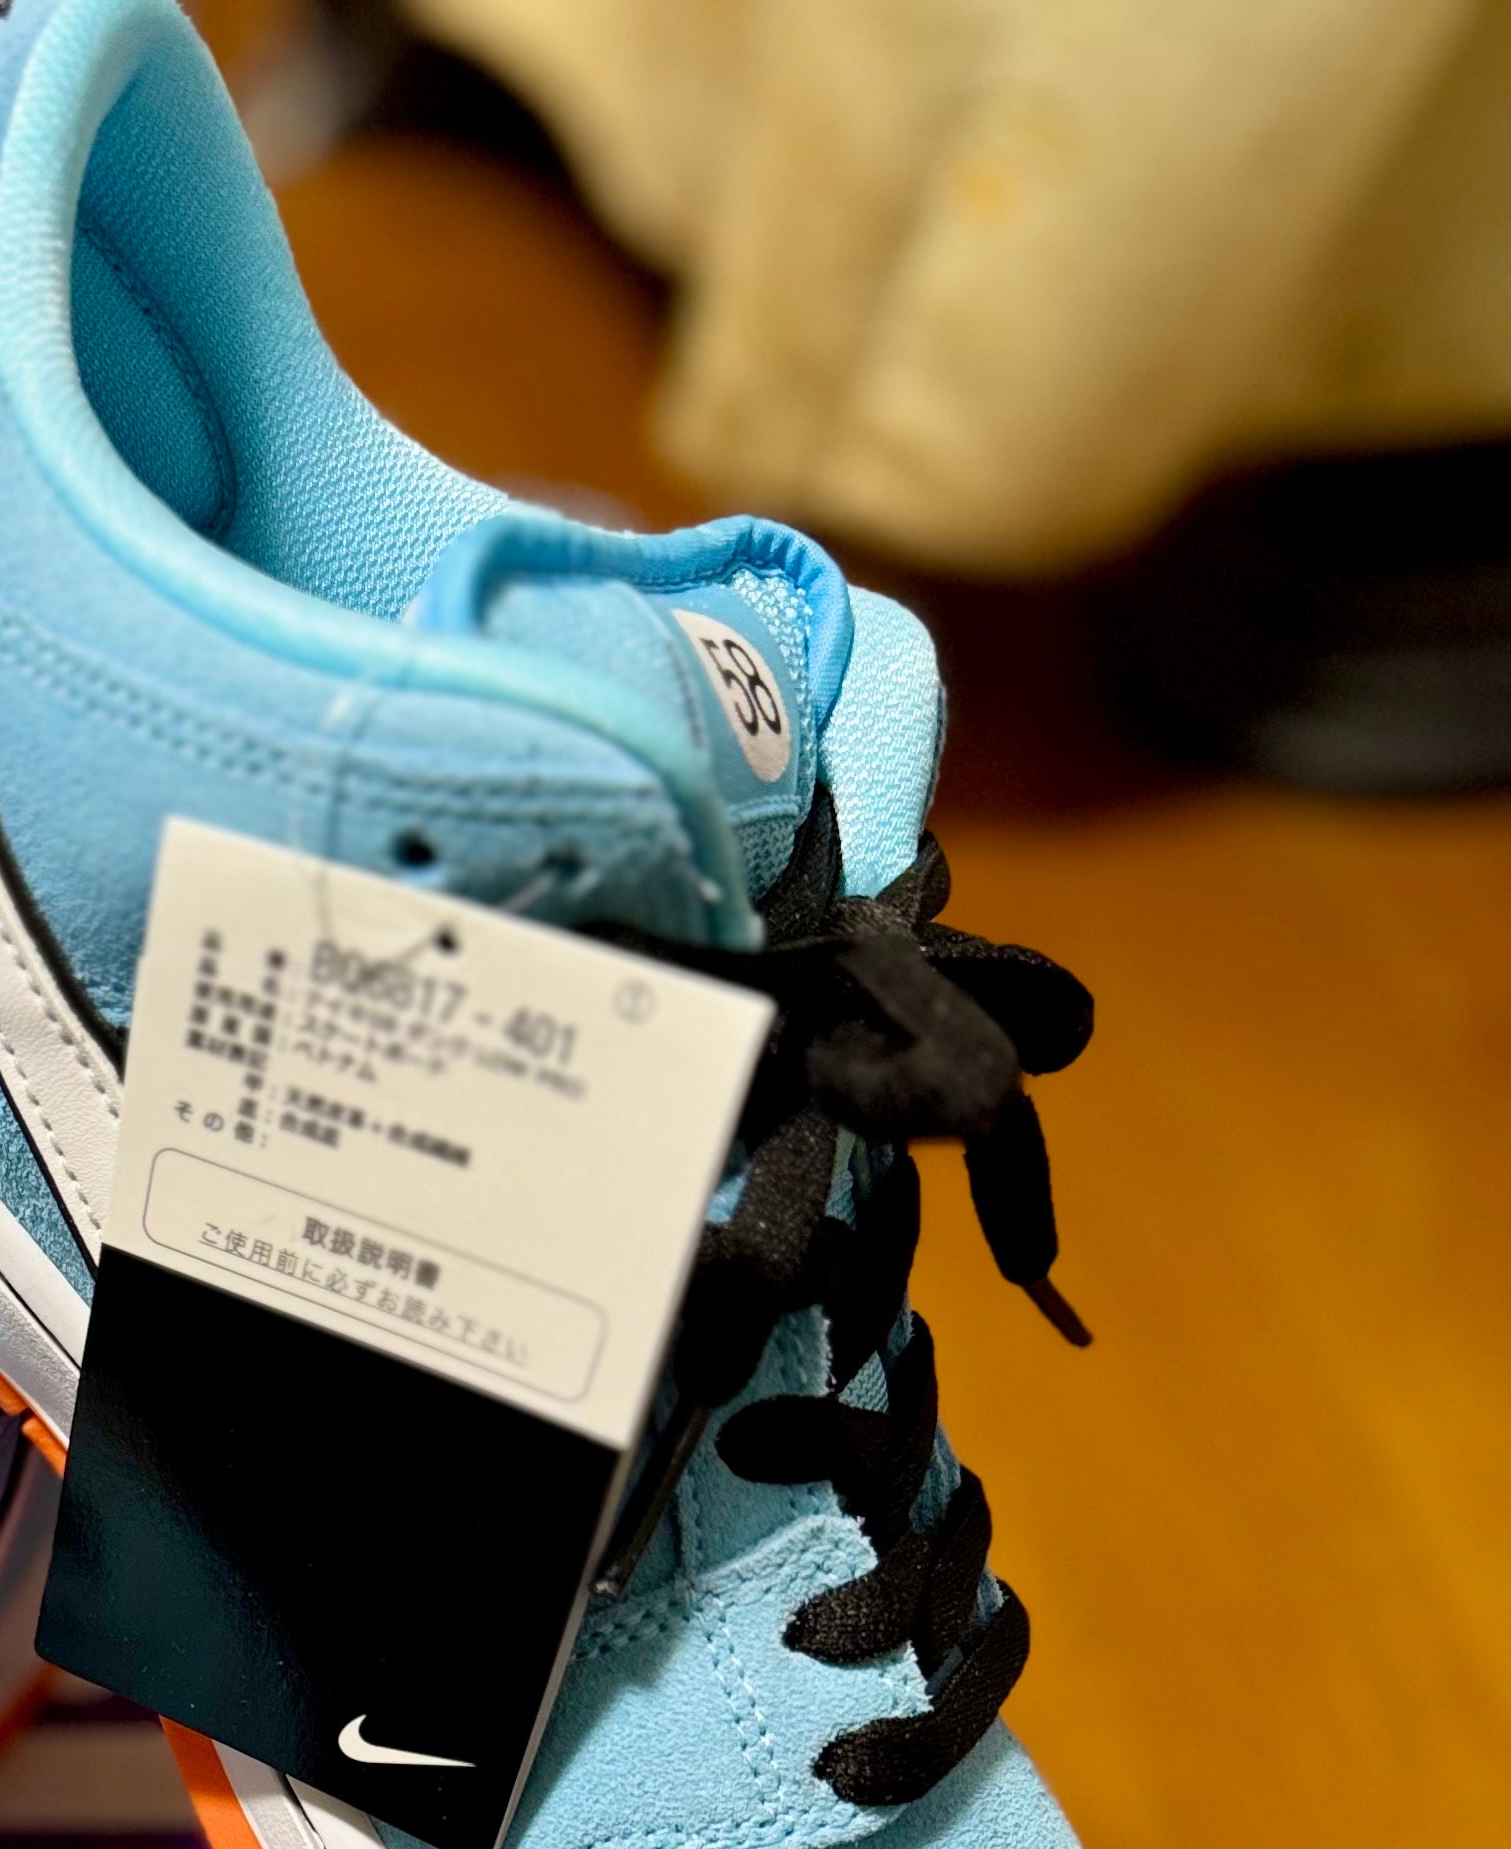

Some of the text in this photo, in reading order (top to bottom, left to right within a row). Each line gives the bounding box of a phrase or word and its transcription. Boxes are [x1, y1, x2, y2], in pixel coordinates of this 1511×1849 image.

[699, 637, 781, 737] 58
[199, 1222, 528, 1365] ご使用前に必ずお読み下さい
[301, 1216, 442, 1291] 取扱説明書
